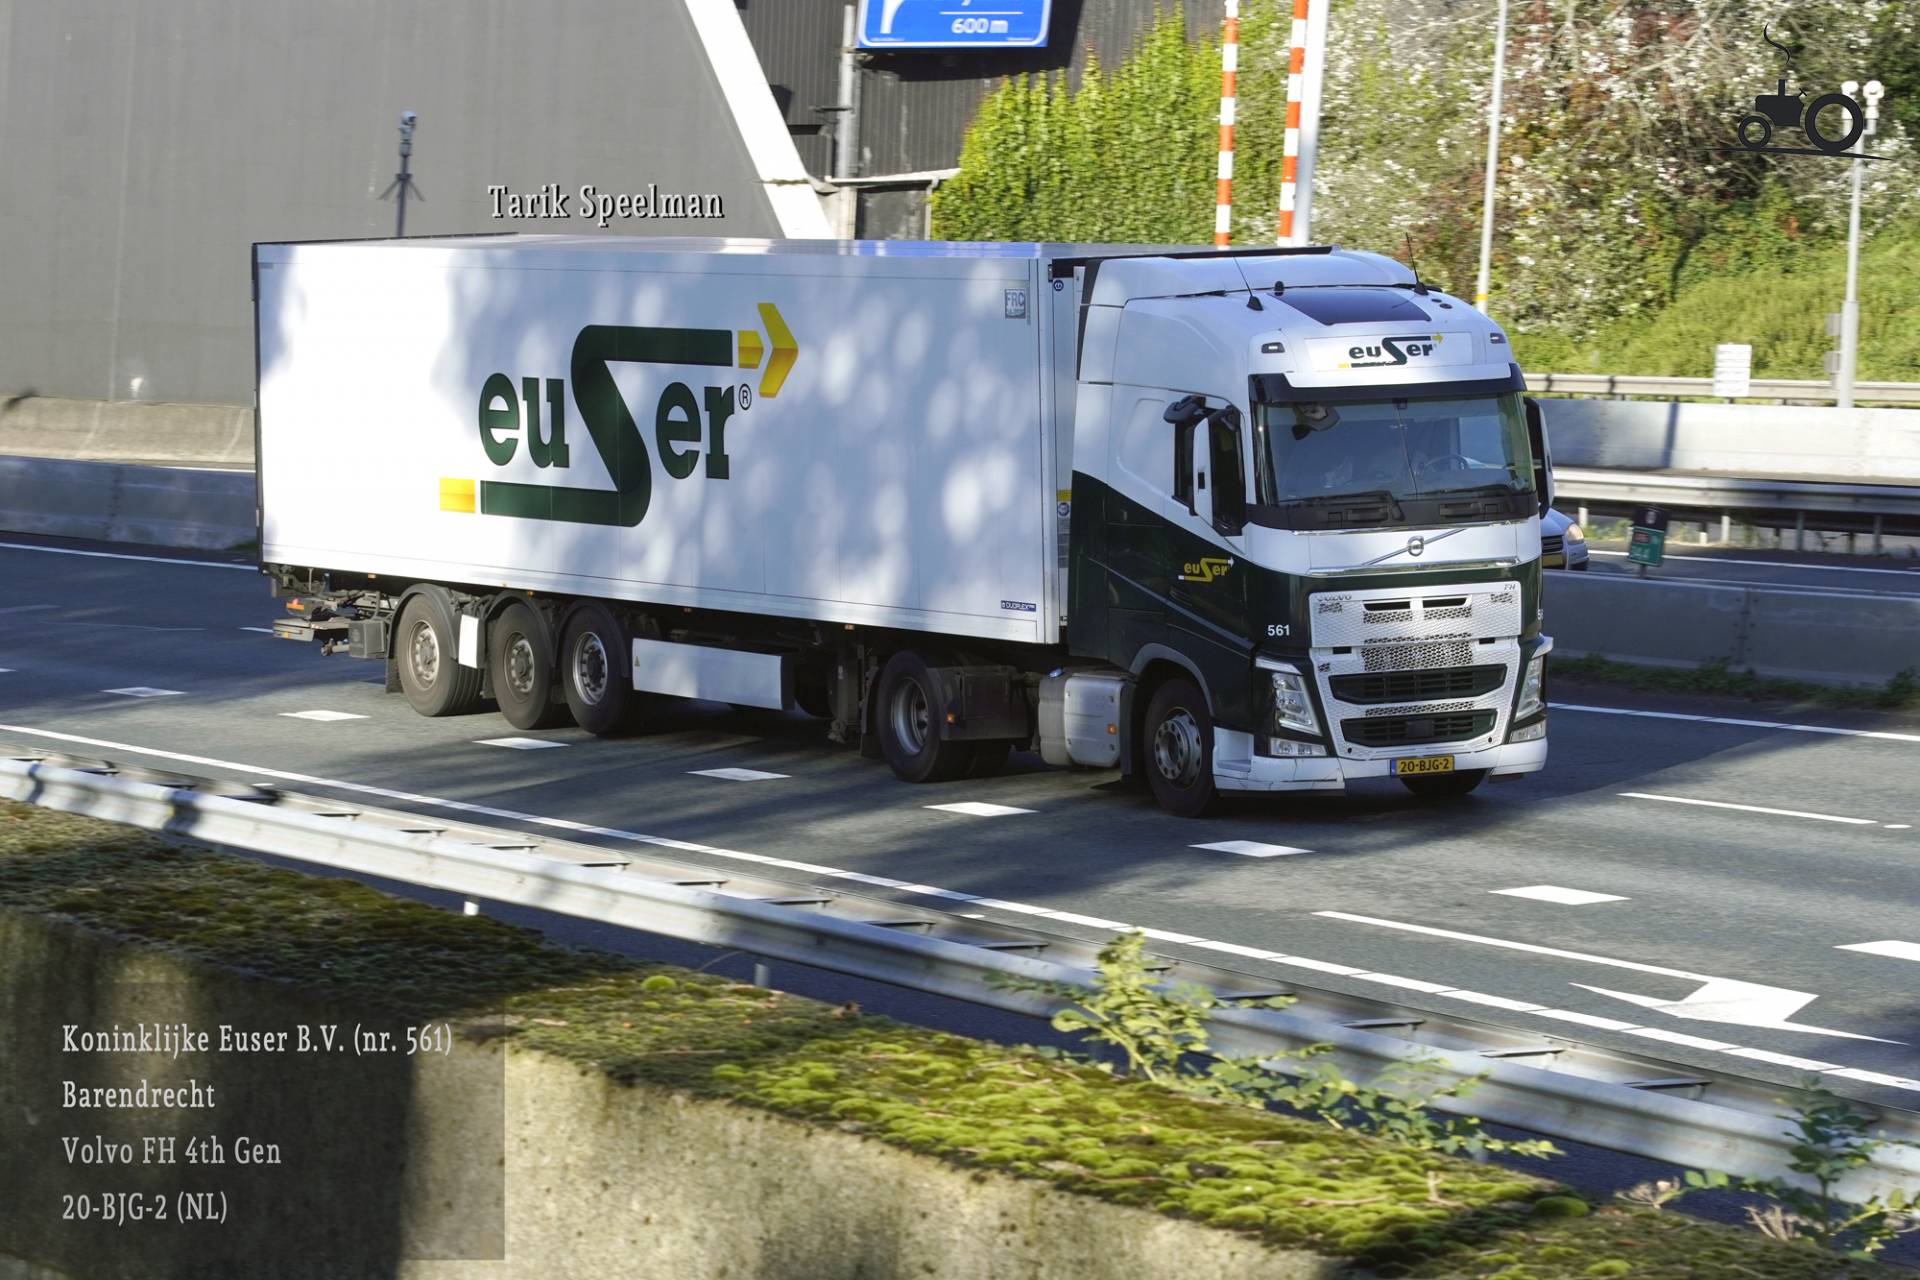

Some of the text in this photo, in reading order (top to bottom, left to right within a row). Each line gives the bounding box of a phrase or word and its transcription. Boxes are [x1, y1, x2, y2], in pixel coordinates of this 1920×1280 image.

[951, 18, 989, 34] 600
[1005, 291, 1025, 307] FRC
[1267, 624, 1290, 637] 561
[1400, 758, 1449, 772] 20-BJG-2
